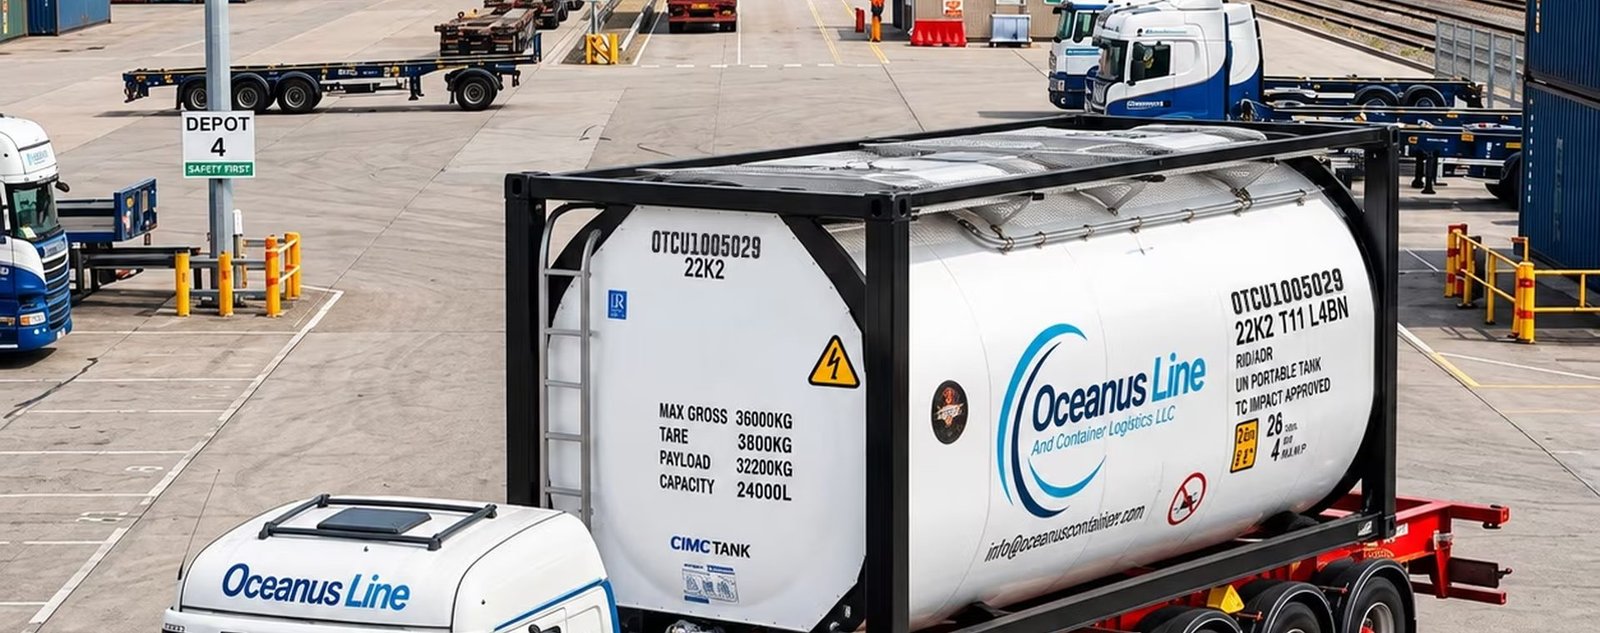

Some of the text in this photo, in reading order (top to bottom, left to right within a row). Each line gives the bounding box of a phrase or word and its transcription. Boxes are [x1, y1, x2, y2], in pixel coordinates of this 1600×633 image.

[186, 116, 250, 131] DEPOT
[211, 137, 226, 156] 4
[188, 164, 250, 174] SAFETY FIRST
[652, 230, 761, 259] OTCU1005029
[684, 257, 725, 279] 22K2
[1231, 268, 1344, 315] OTCU1005029
[1235, 296, 1349, 346] 22K2 T11 L4BN
[1236, 346, 1273, 369] RID/ADR
[1236, 357, 1322, 392] UN PORTABLE TANK
[1033, 352, 1206, 432] Oceanus Line
[1235, 378, 1331, 416] TC IMPACT APPROVED
[659, 402, 793, 429] MAX GROSS 36000KG
[659, 426, 792, 453] TARE 3800KG
[1031, 405, 1176, 456] And Container Logistics LLC
[660, 450, 793, 477] PAYLOAD 32200KG
[1271, 438, 1281, 462] 4
[660, 474, 792, 501] CAPACITY 24000L
[670, 536, 751, 558] CIMC TANK
[222, 563, 410, 611] Oceanus Line
